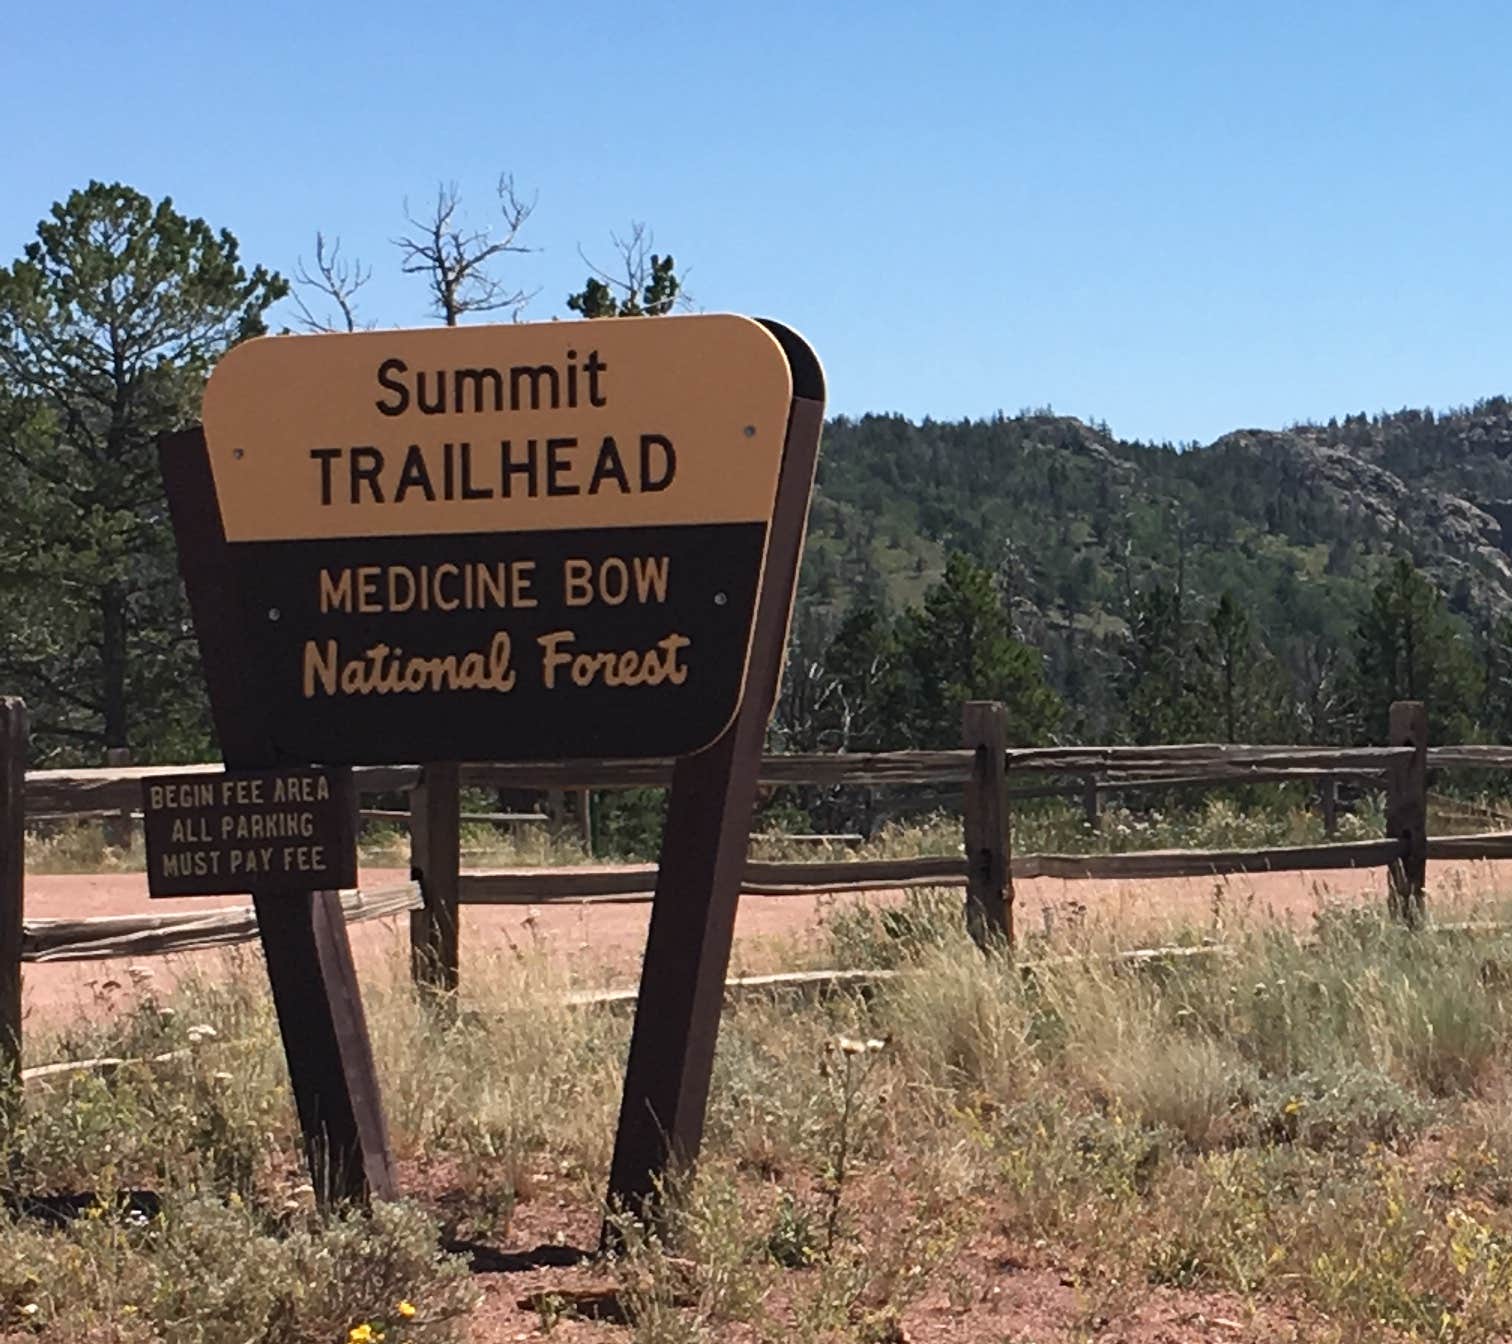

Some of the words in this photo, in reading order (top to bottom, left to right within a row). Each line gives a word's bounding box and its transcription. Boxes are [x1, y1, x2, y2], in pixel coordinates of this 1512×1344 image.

[375, 350, 607, 417] Summit
[311, 433, 677, 505] TRAILHEAD
[320, 561, 537, 613] MEDICINE
[564, 556, 669, 605] BOW
[302, 632, 516, 696] National
[537, 630, 691, 688] Forest
[151, 783, 213, 809] BEGIN
[222, 779, 264, 805] FEE
[273, 775, 329, 802] AREA
[172, 818, 213, 842] ALL
[222, 812, 313, 840] PARKING
[163, 851, 221, 877] MUST
[231, 847, 274, 874] PAY
[284, 846, 327, 871] FEE
